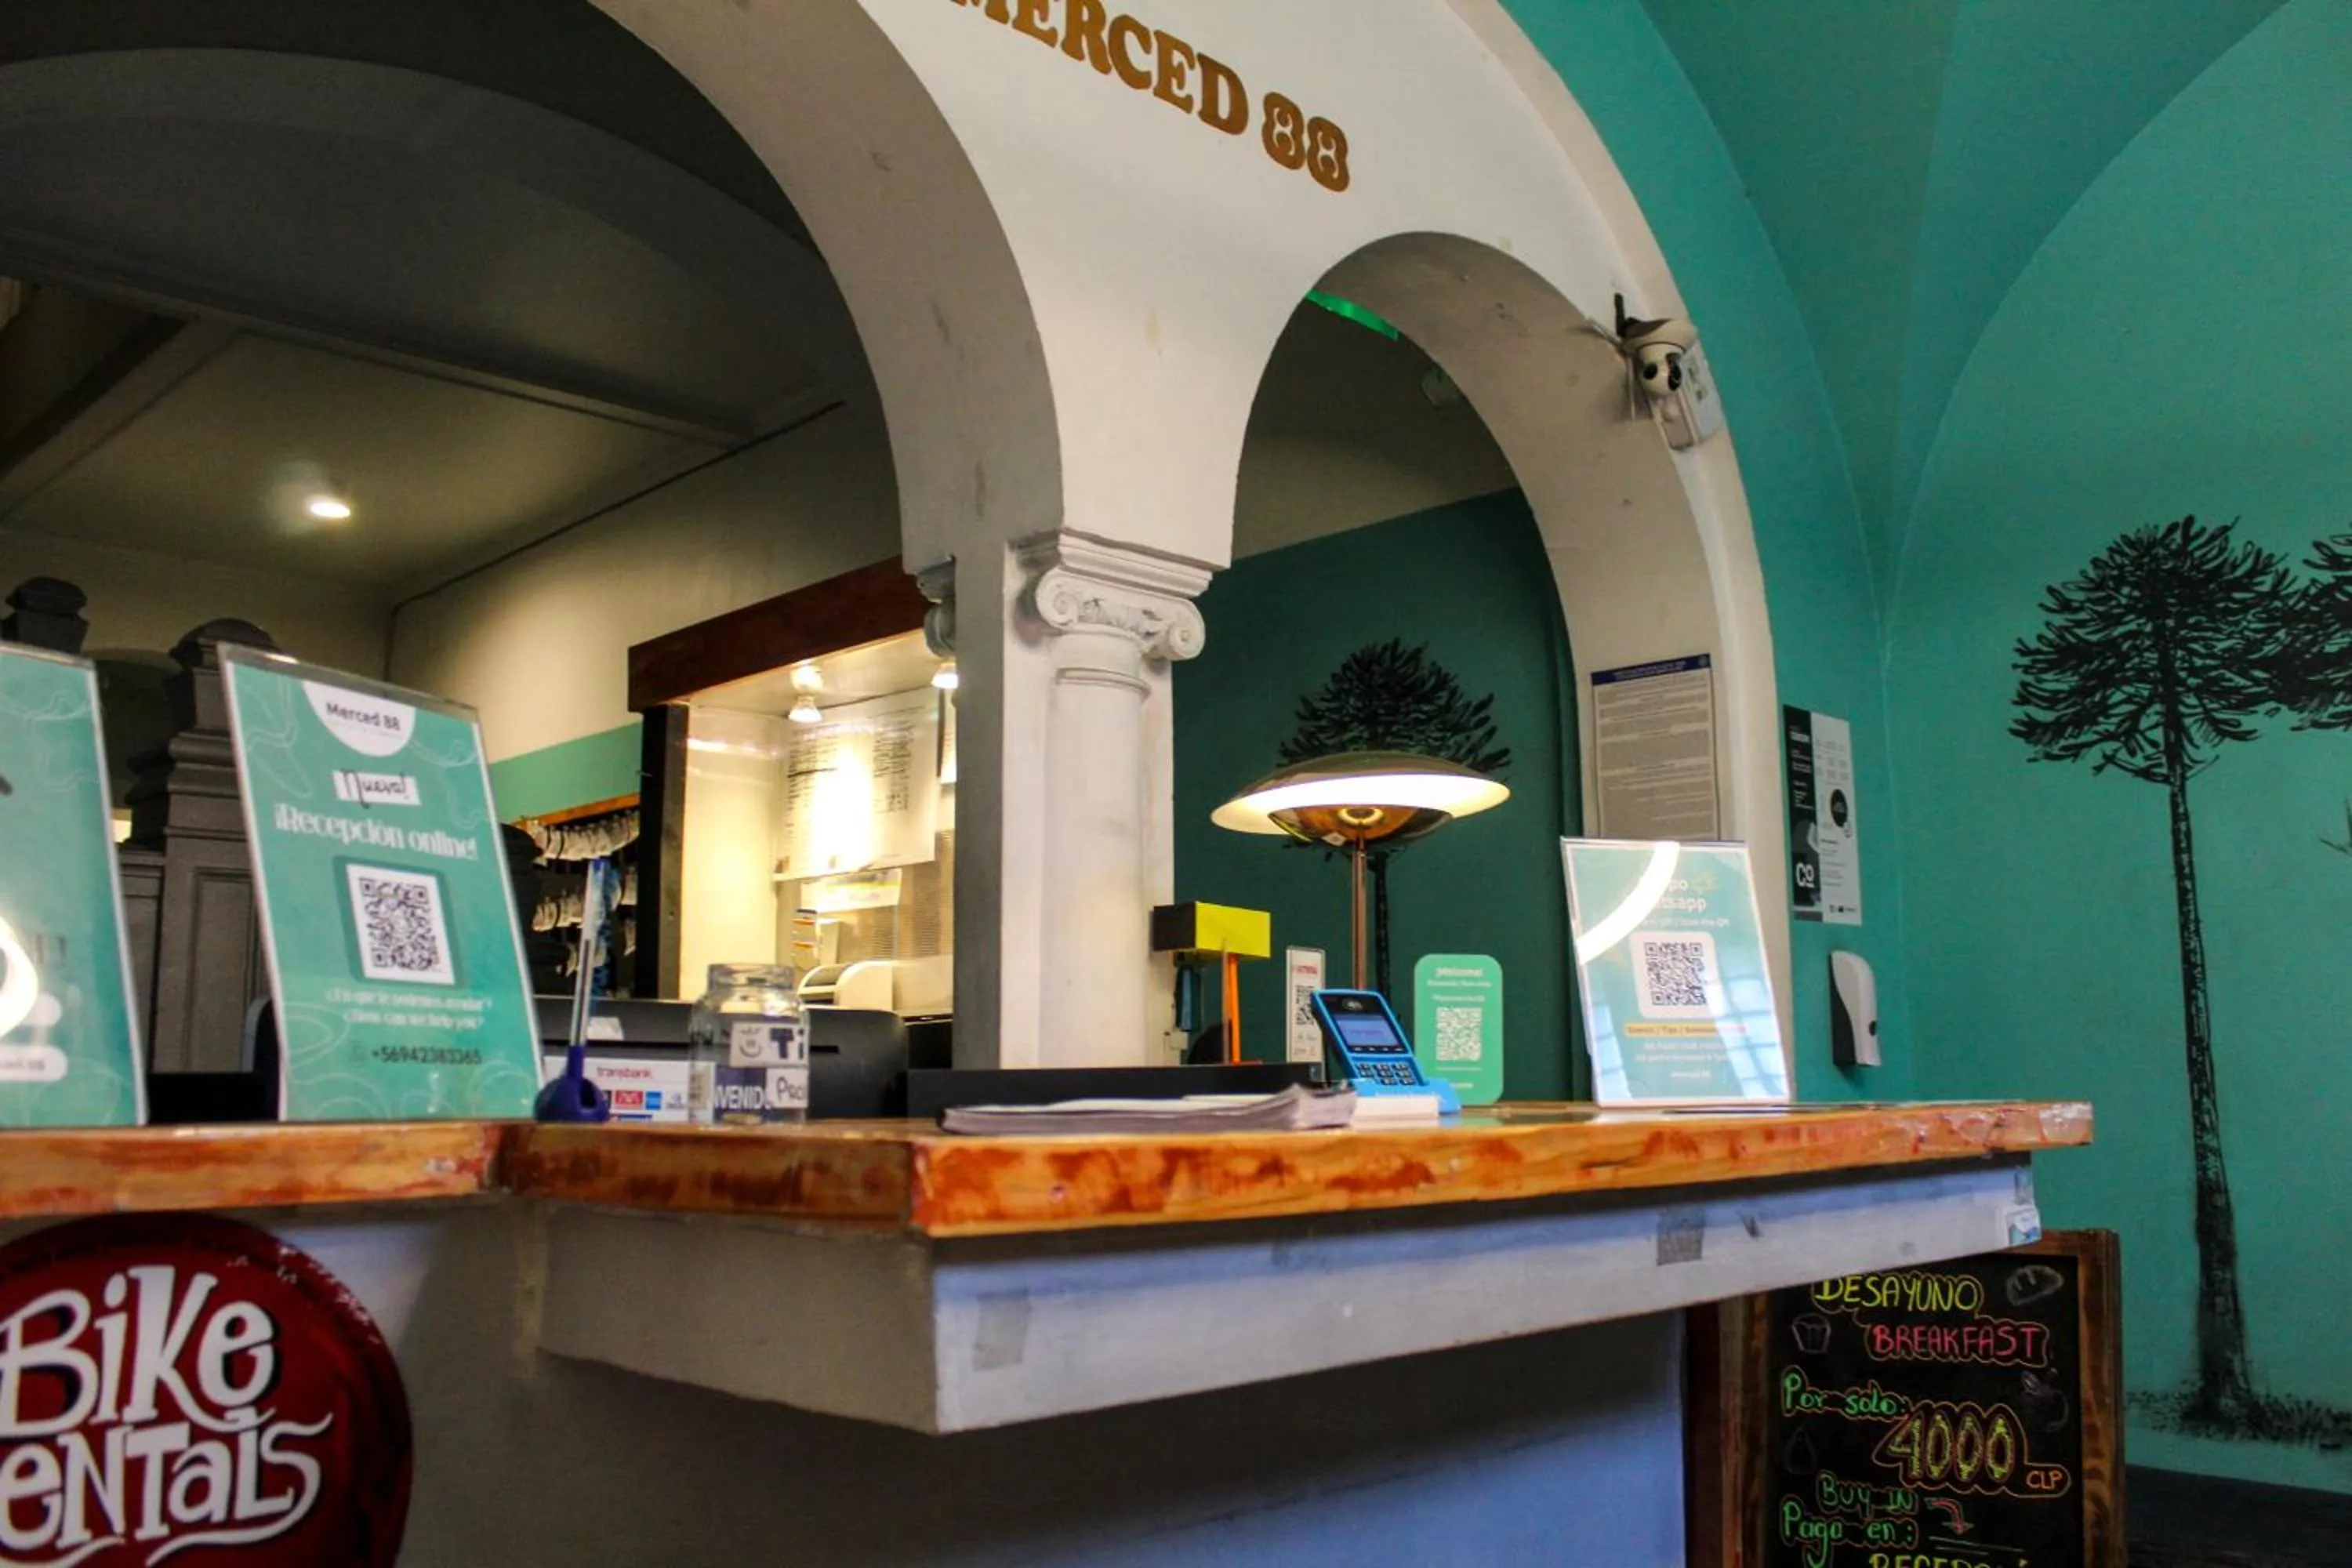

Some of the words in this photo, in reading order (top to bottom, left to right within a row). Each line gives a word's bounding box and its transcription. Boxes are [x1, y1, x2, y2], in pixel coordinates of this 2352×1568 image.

[1261, 92, 1350, 193] 88
[326, 702, 379, 728] Merced
[383, 717, 401, 731] 88
[1813, 1275, 1978, 1312] DESAYUNO
[1871, 1323, 2041, 1358] BREAKFAST
[1784, 1373, 1825, 1409] Por
[1886, 1413, 2015, 1483] 4000
[2026, 1470, 2064, 1490] CLP
[1783, 1501, 1843, 1568] Pago
